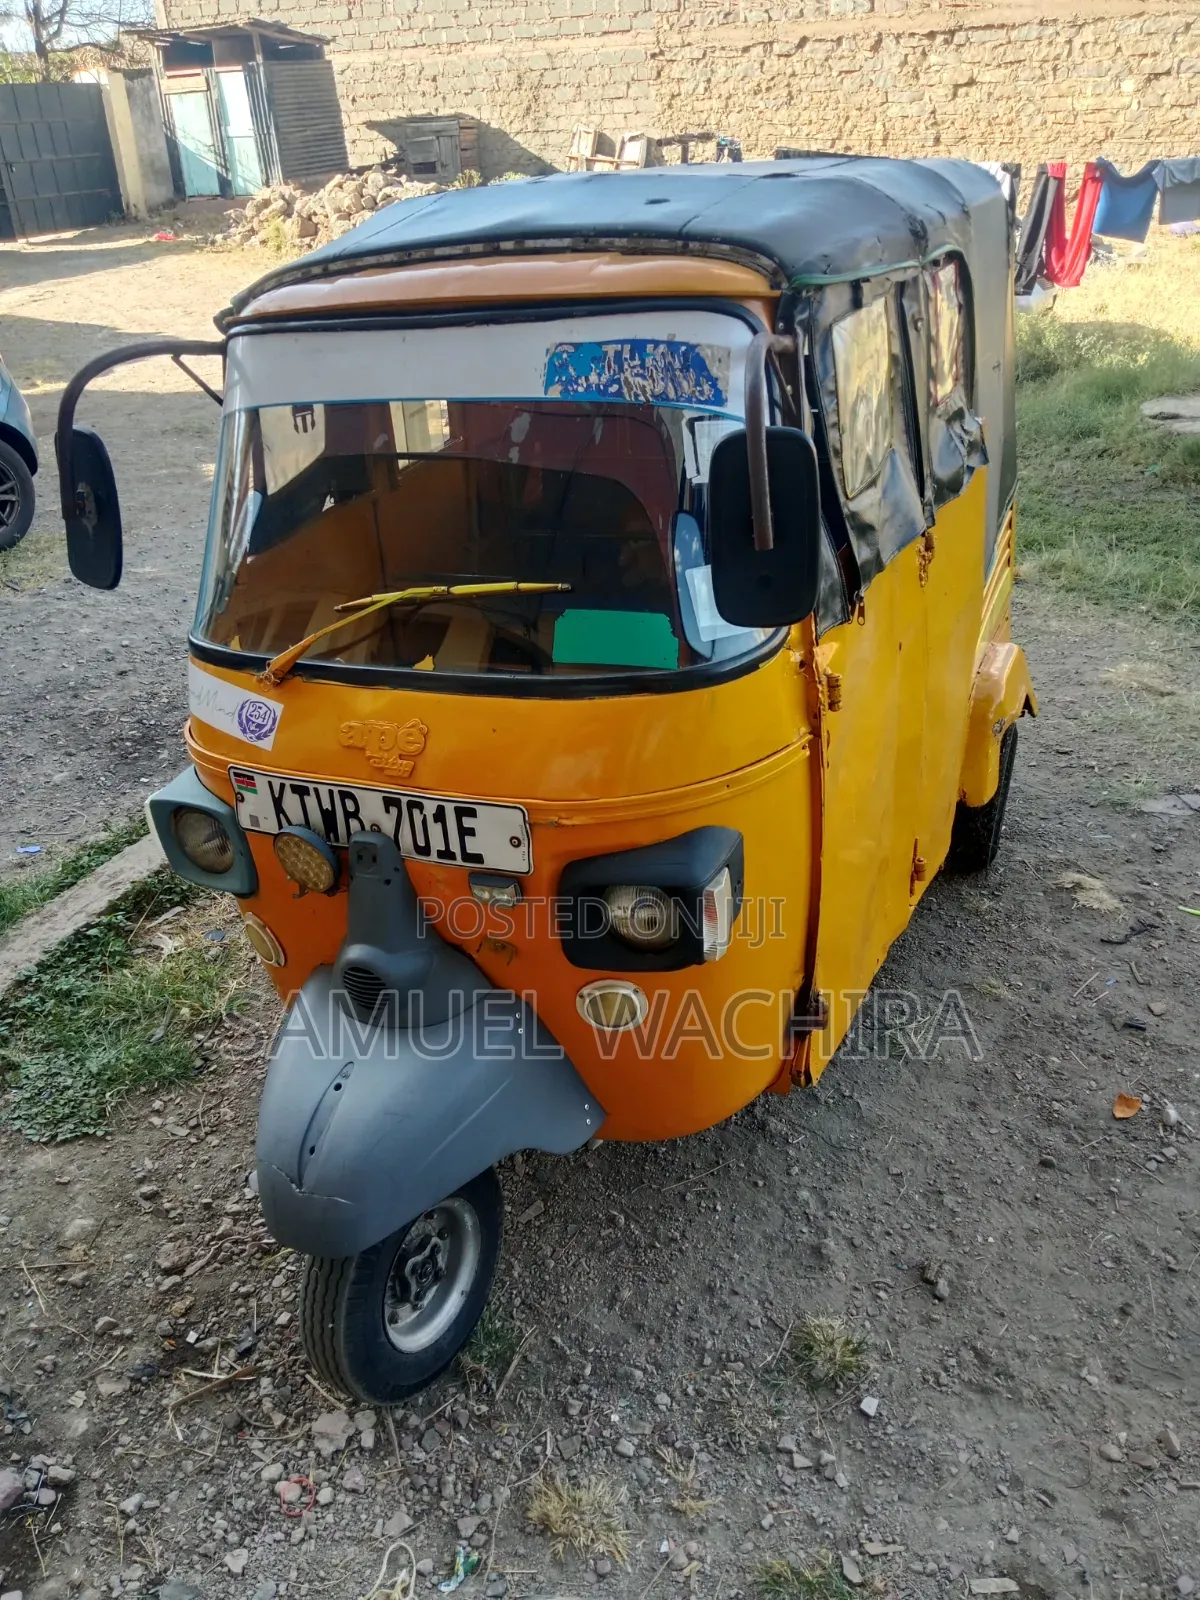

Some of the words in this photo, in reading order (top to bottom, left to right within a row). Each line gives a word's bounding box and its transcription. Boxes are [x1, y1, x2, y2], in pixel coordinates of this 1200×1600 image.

[249, 703, 269, 723] 254
[267, 780, 367, 844] KTWB
[382, 795, 485, 865] 701E
